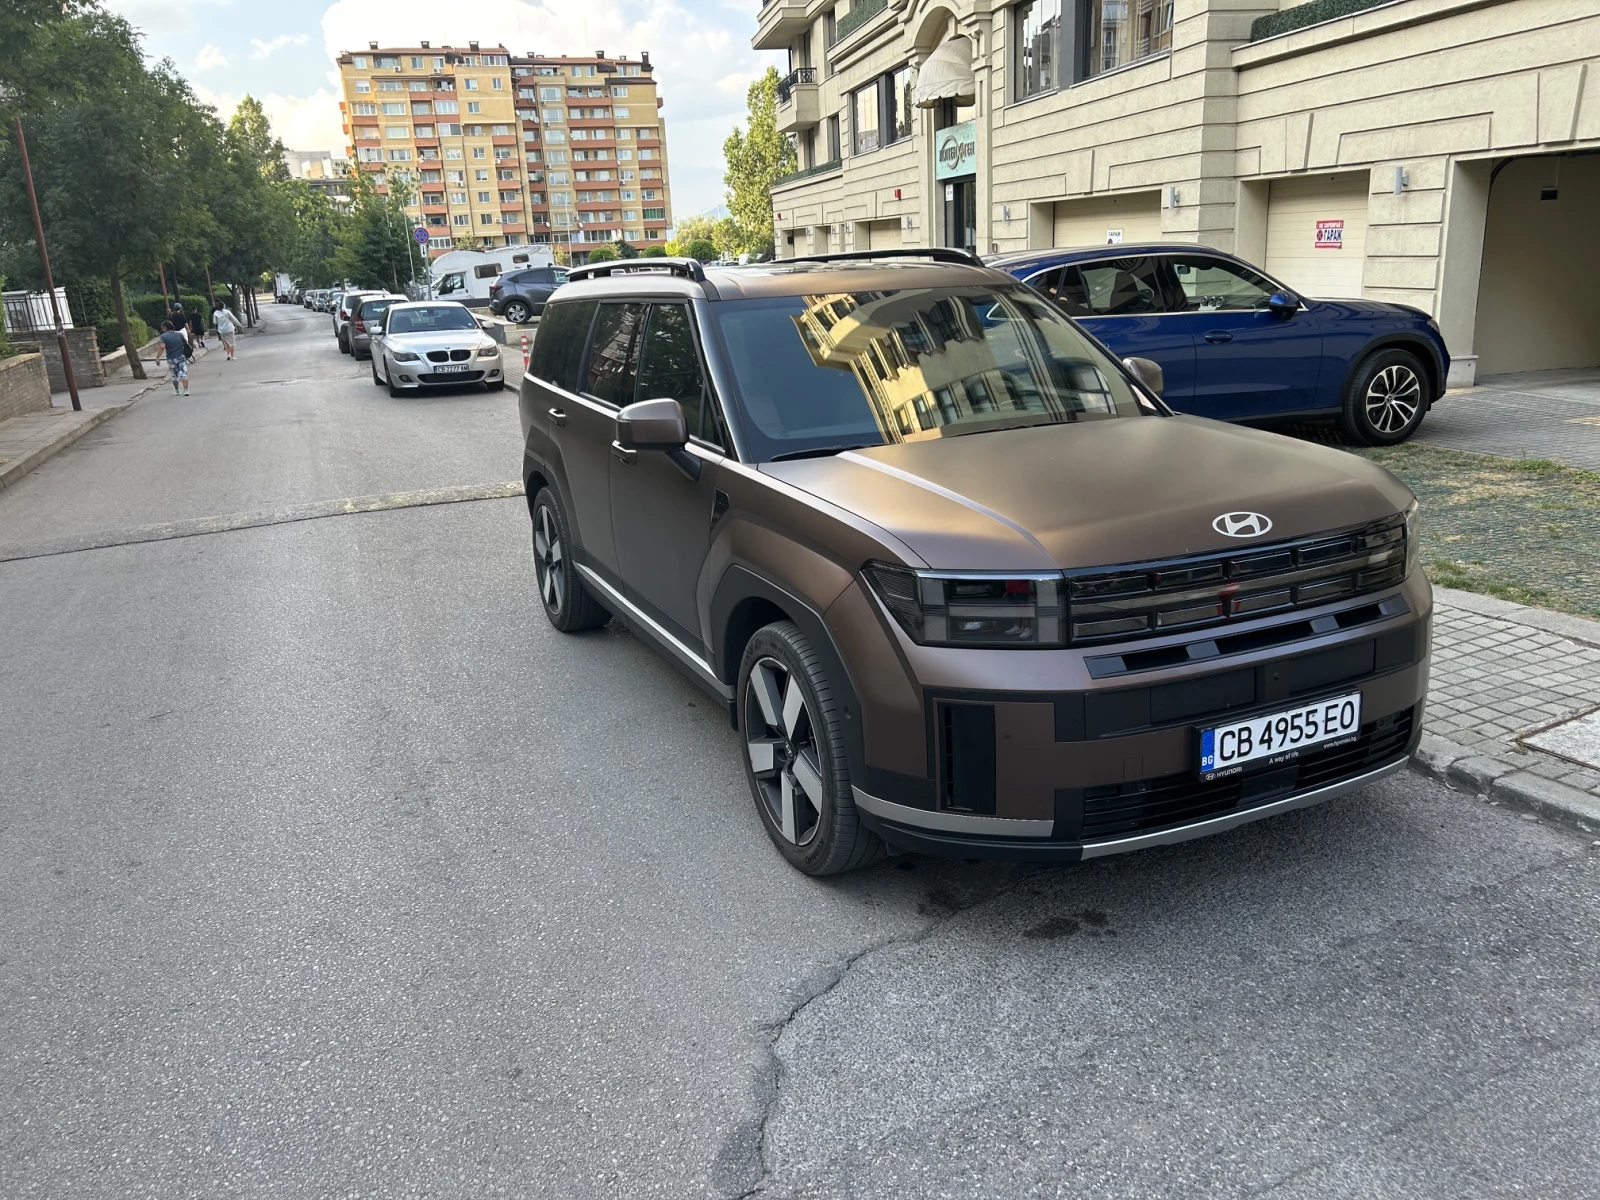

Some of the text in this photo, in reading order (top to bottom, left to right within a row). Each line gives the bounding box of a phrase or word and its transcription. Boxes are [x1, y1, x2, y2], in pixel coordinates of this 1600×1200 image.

[1323, 229, 1343, 241] ГАРАЖ
[1219, 700, 1355, 762] CB 4955 EO
[1201, 755, 1214, 767] BG
[1274, 755, 1284, 763] way
[1285, 752, 1291, 760] of
[1290, 750, 1299, 758] life
[1216, 766, 1243, 778] HYUNDAI
[804, 838, 825, 865] KUMHO
